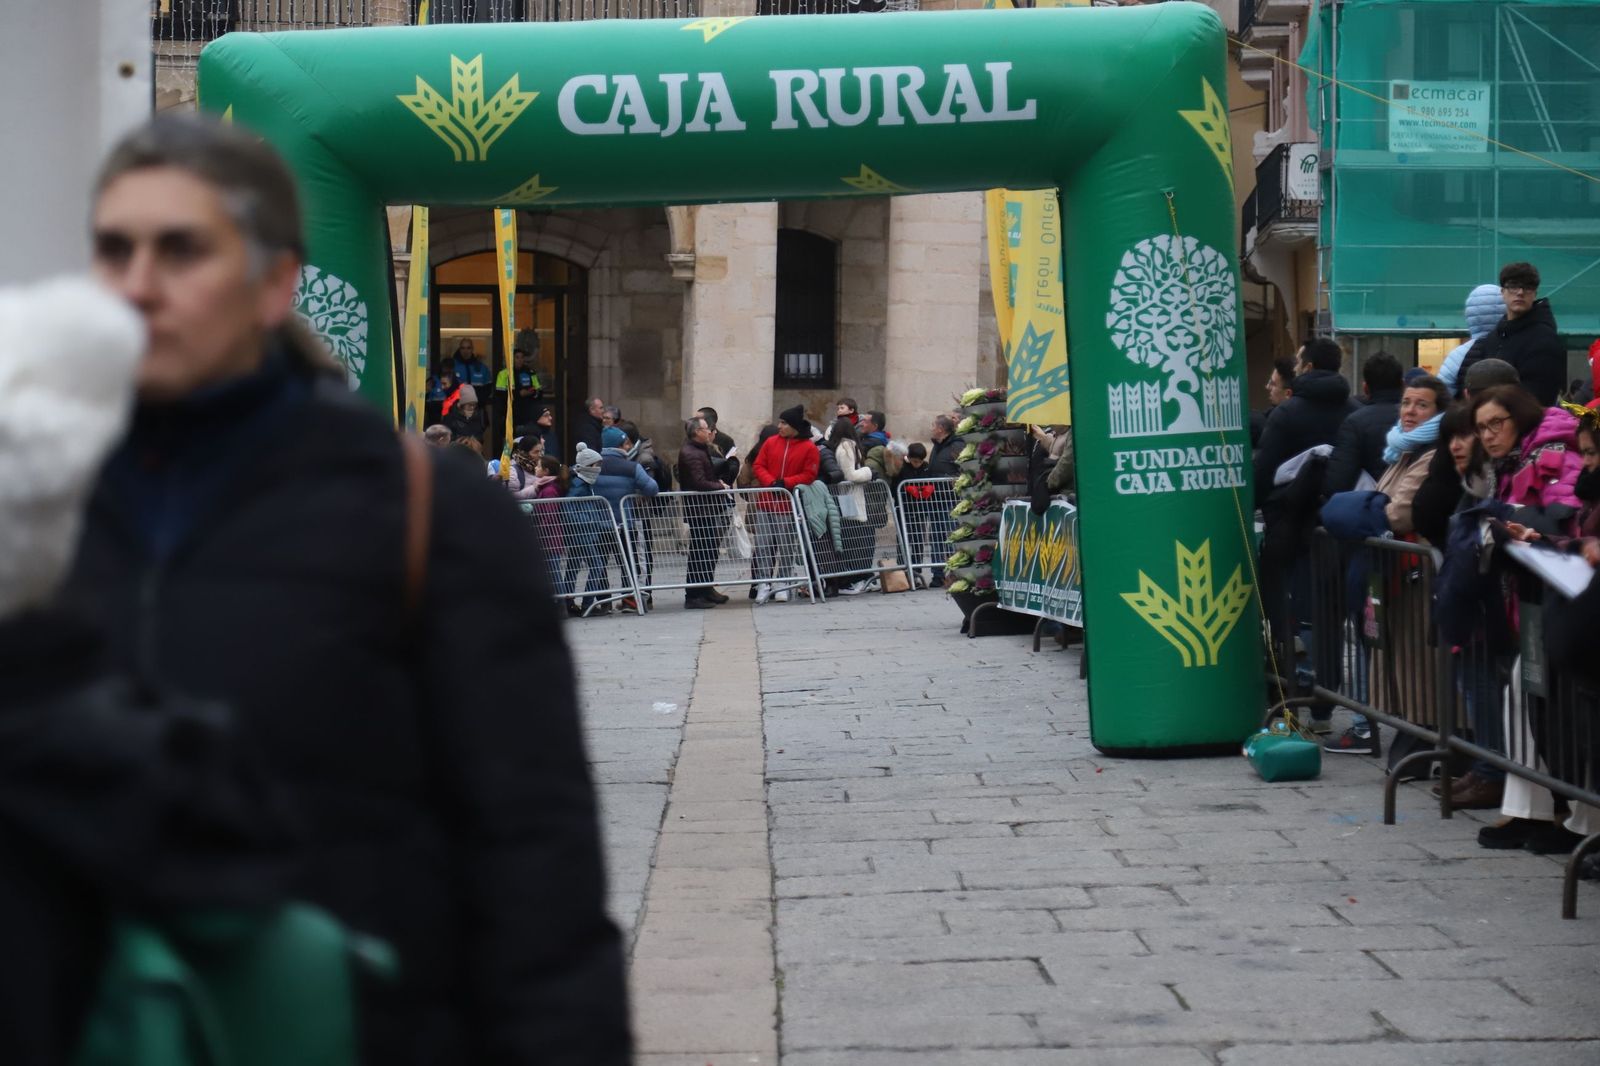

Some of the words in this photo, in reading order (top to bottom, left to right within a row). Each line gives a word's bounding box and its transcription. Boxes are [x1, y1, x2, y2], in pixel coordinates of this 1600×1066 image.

[557, 72, 746, 137] CAJA
[769, 61, 1037, 130] RURAL
[1420, 106, 1436, 118] 980
[1437, 107, 1453, 118] 695
[1454, 107, 1470, 118] 254
[1398, 119, 1478, 129] www.tecmacar.com
[1113, 444, 1245, 472] FUNDACION
[1115, 472, 1176, 495] CAJA
[1180, 467, 1247, 491] RURAL
